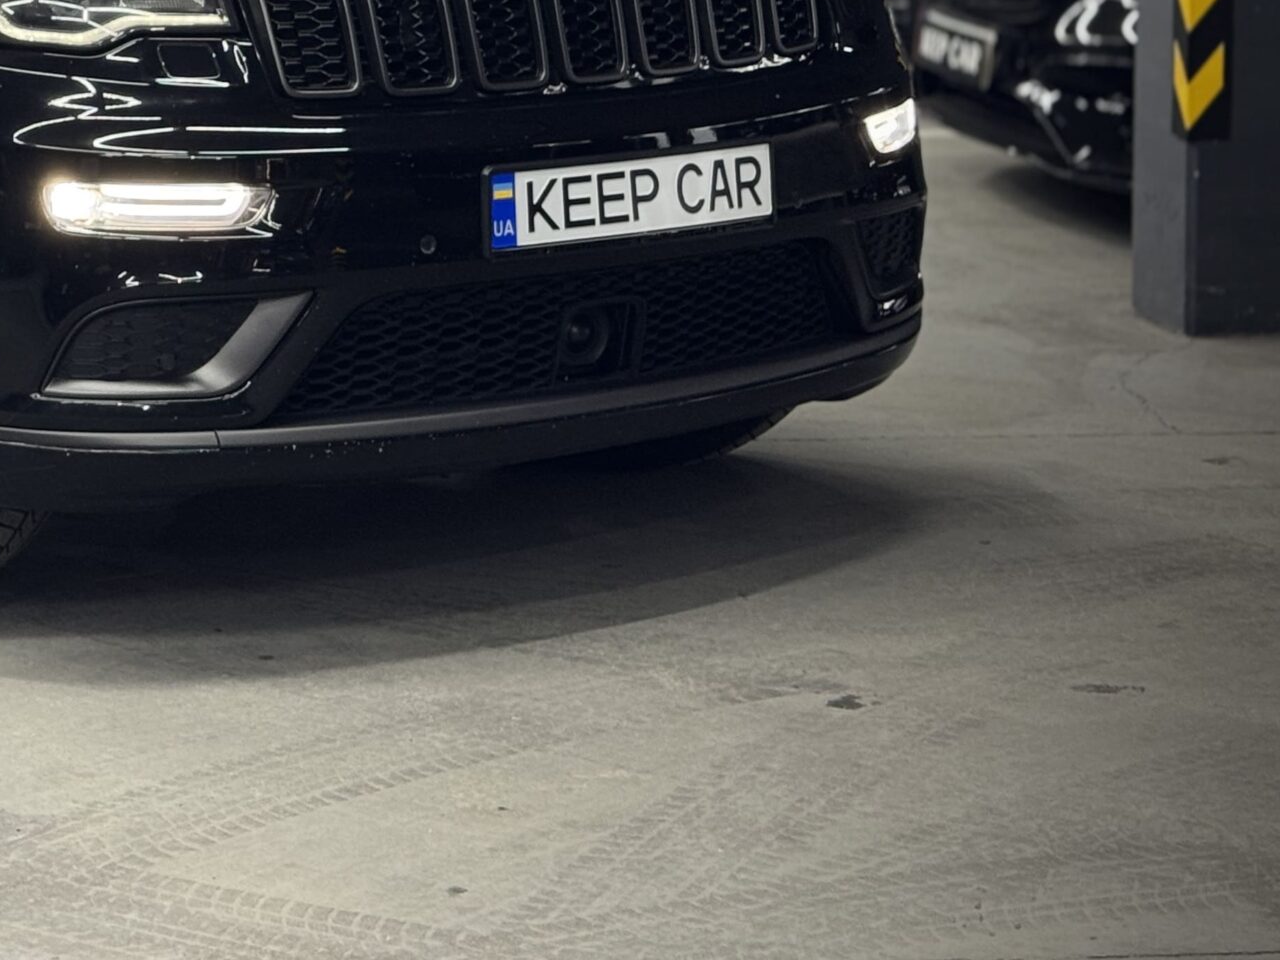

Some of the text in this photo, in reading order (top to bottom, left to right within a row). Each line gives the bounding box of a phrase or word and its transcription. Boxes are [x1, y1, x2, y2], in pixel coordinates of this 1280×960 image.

[526, 156, 763, 233] KEEP CAR
[493, 218, 515, 237] UA
